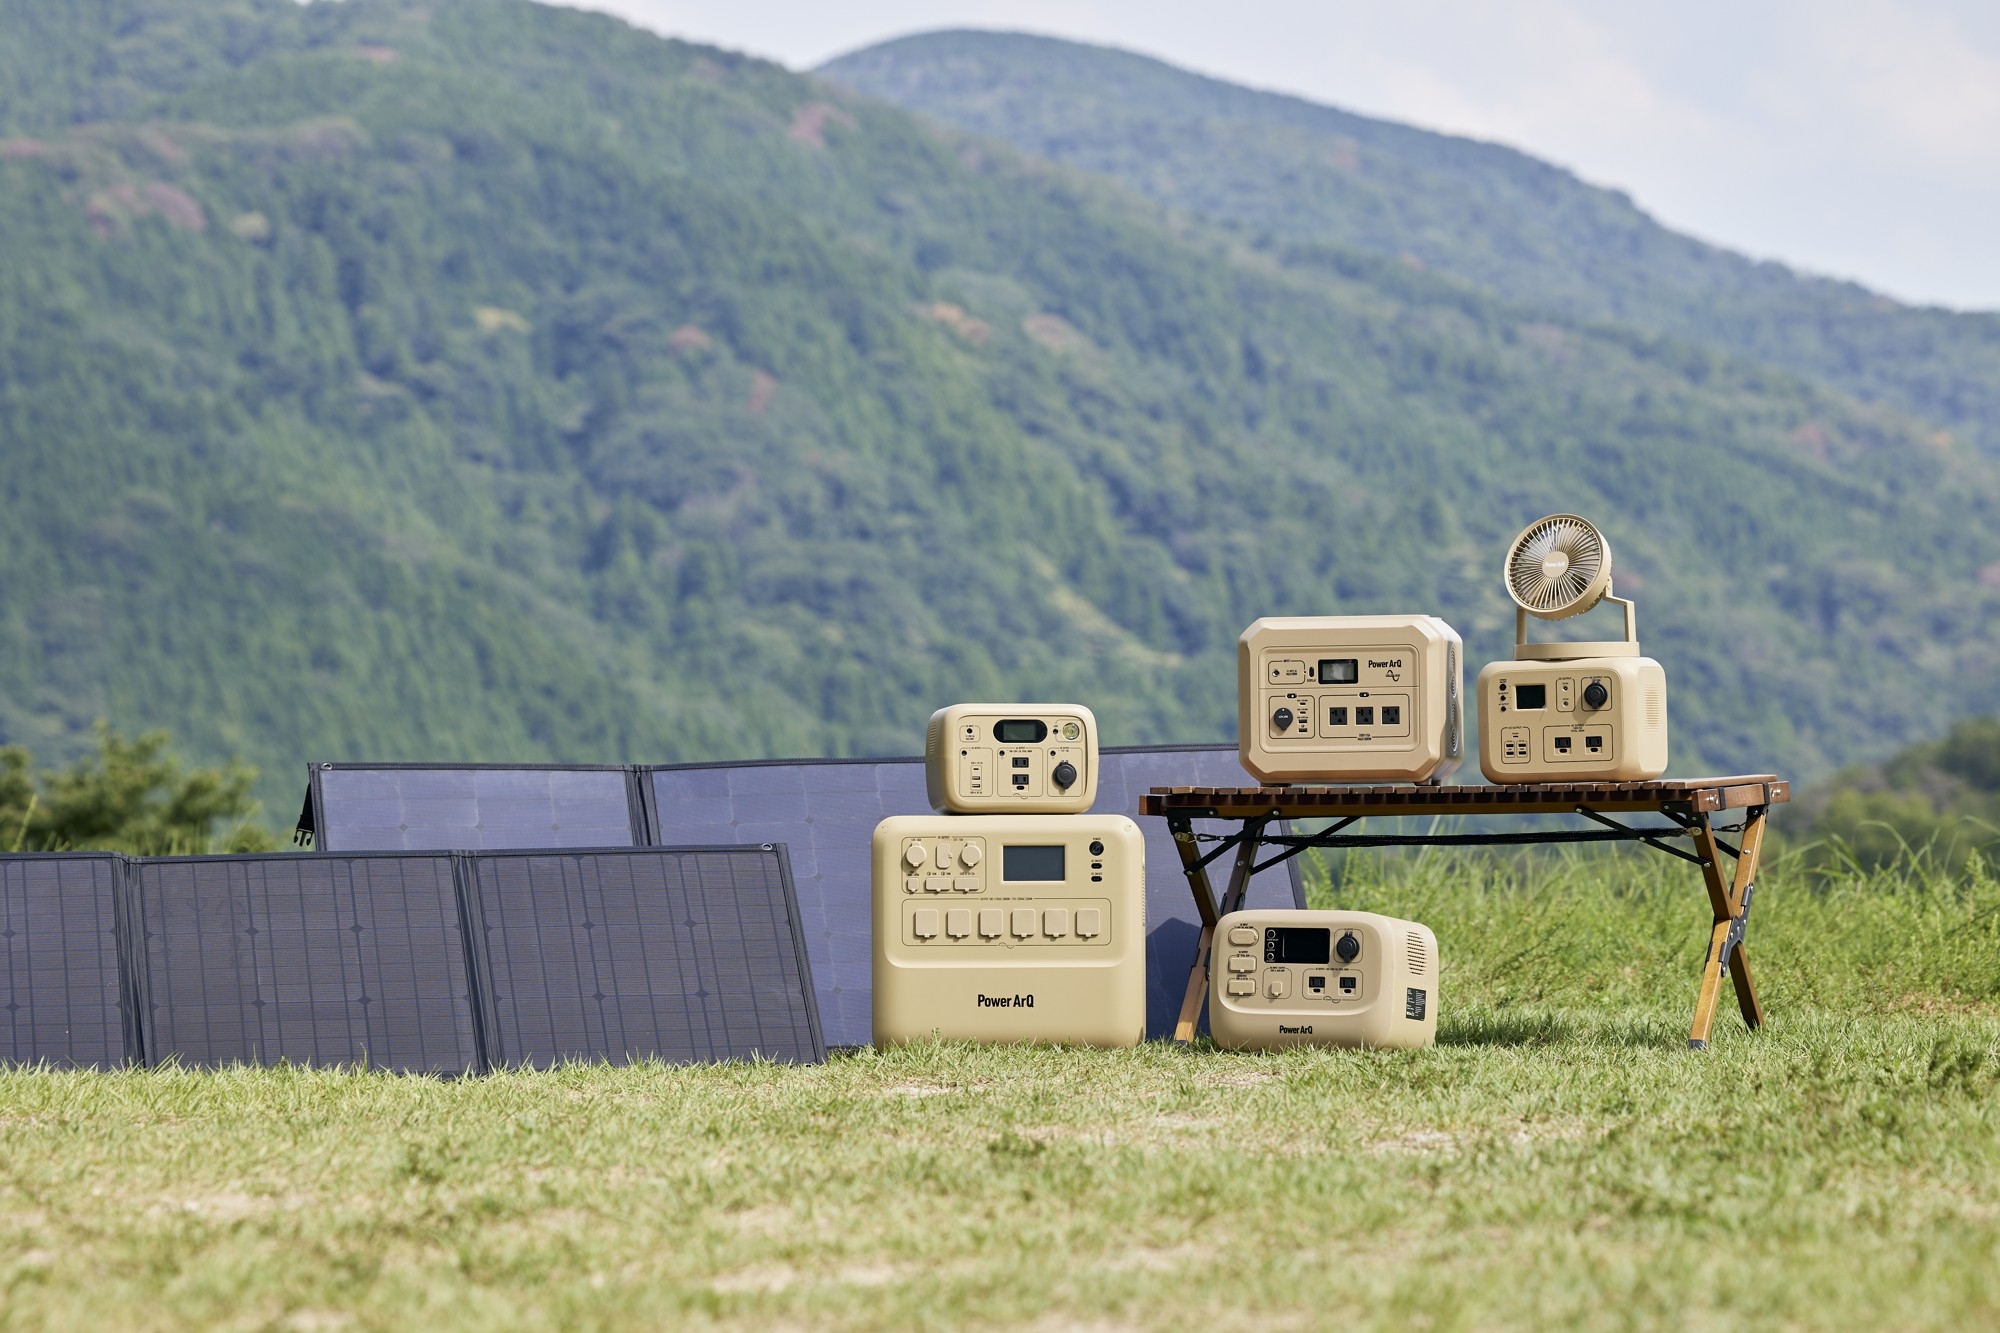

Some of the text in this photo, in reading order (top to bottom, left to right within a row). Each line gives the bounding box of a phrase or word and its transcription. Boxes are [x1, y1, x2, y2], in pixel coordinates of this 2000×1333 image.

[1368, 659, 1402, 668] Power ArQ
[977, 994, 1034, 1008] Power ArQ
[1279, 1025, 1313, 1034] Power ArQ
